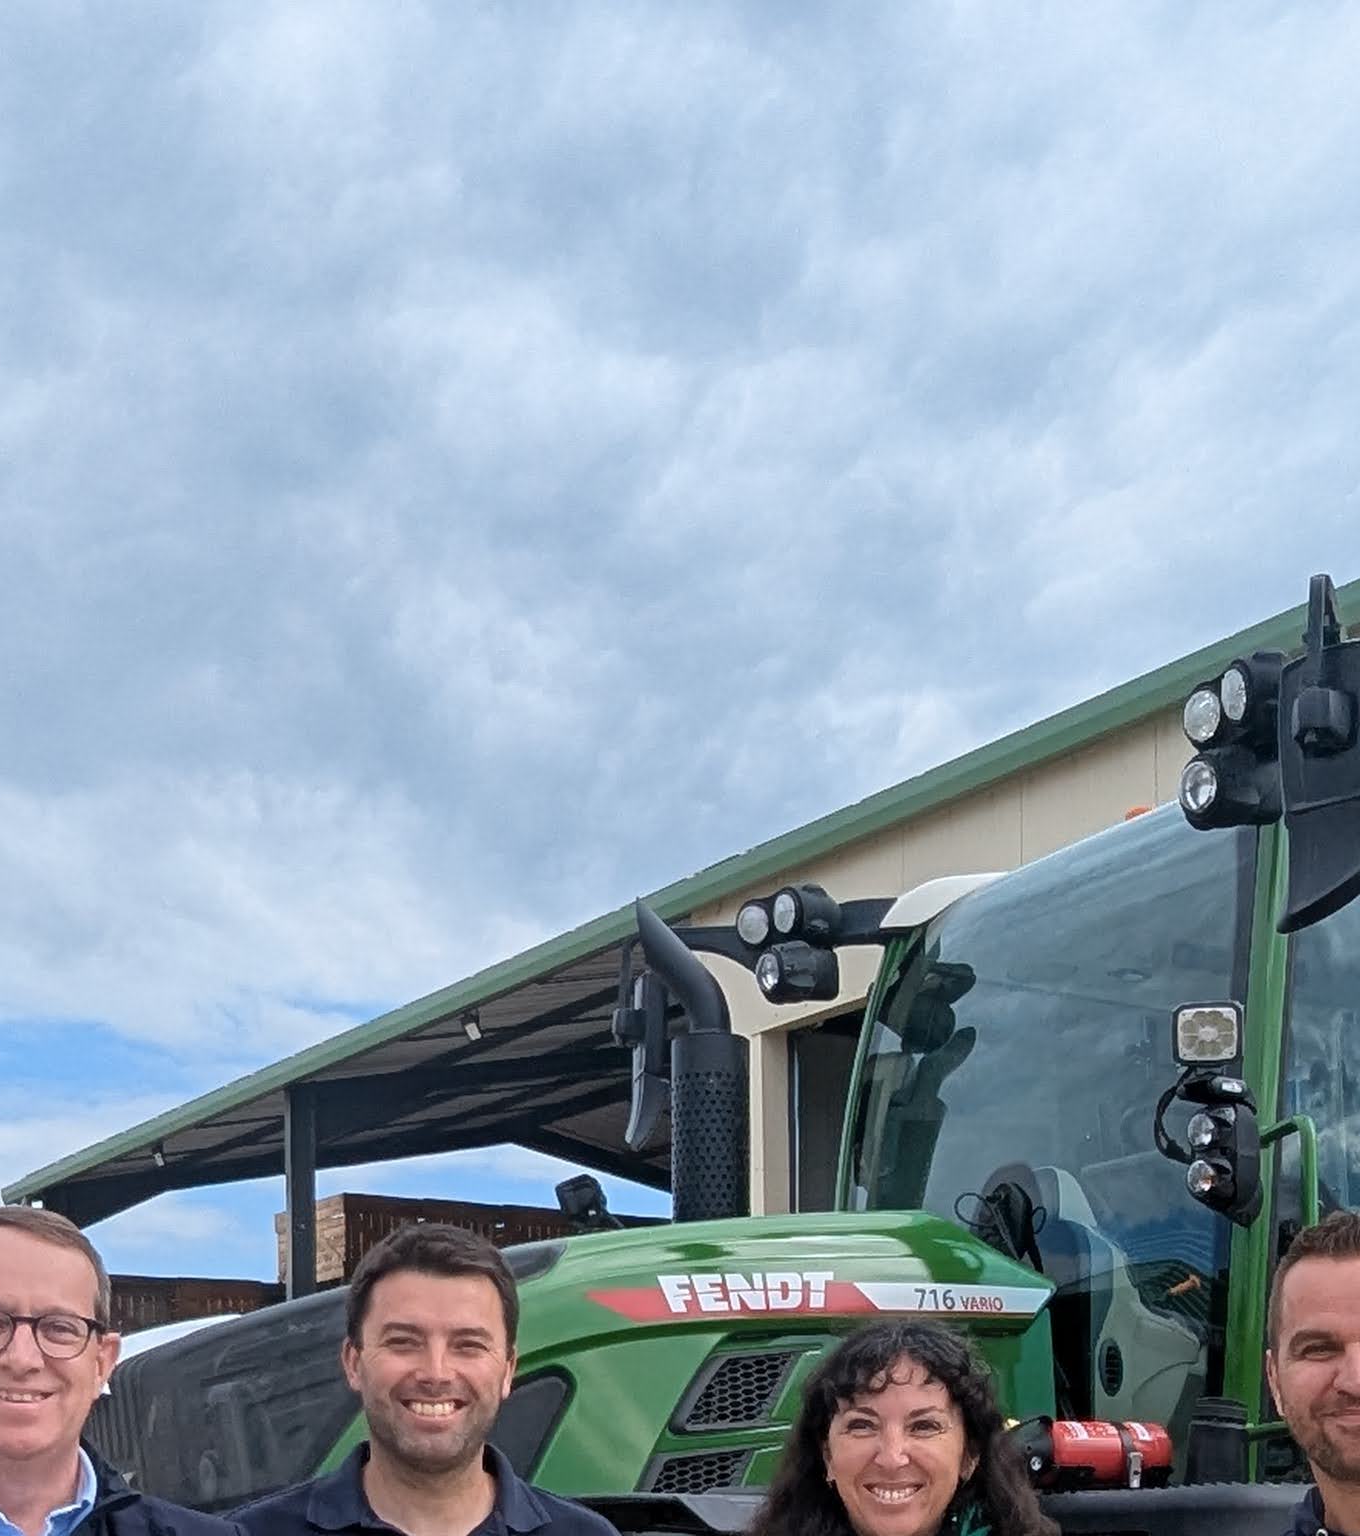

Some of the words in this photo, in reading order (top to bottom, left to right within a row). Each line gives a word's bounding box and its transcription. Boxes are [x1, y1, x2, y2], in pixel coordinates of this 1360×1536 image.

[657, 1271, 834, 1313] FENDT
[914, 1288, 956, 1310] 716
[960, 1295, 1004, 1311] VARIO
